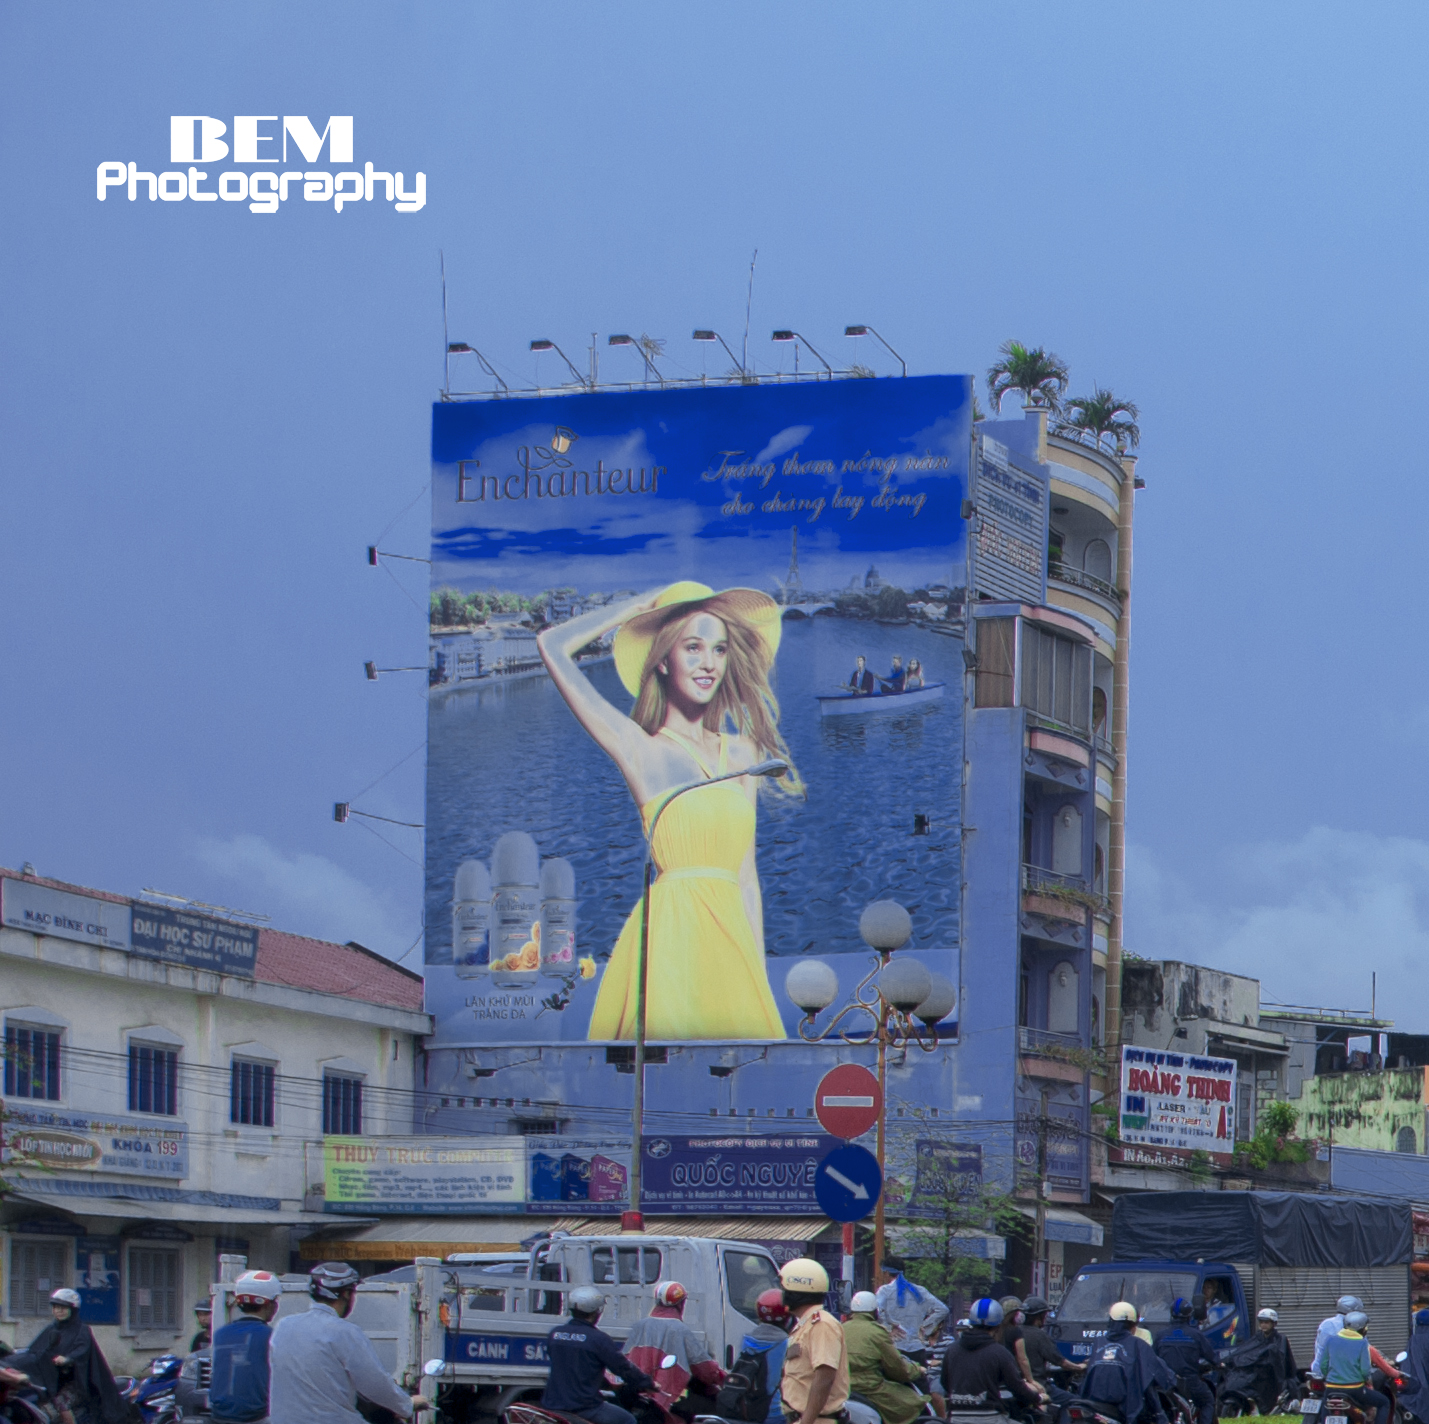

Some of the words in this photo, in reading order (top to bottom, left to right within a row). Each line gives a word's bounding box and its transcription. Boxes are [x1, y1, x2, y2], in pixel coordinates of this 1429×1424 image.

[905, 450, 950, 471] nàn
[456, 446, 667, 503] Enchanteur
[722, 492, 755, 515] cho
[762, 491, 826, 524] chàng
[832, 485, 865, 521] lay
[134, 918, 157, 939] ĐẠI
[161, 926, 190, 946] HỌC
[193, 930, 213, 947] SƯ
[214, 937, 254, 959] PHẠM
[511, 1010, 526, 1019] DA
[1186, 1076, 1231, 1105] THỊNH
[157, 1140, 178, 1156] 199
[1124, 1148, 1135, 1161] IN
[671, 1154, 735, 1188] QUỐC
[787, 1276, 814, 1286] CSGT
[553, 1332, 586, 1342] ENGLAND
[468, 1338, 509, 1359] CẢNH
